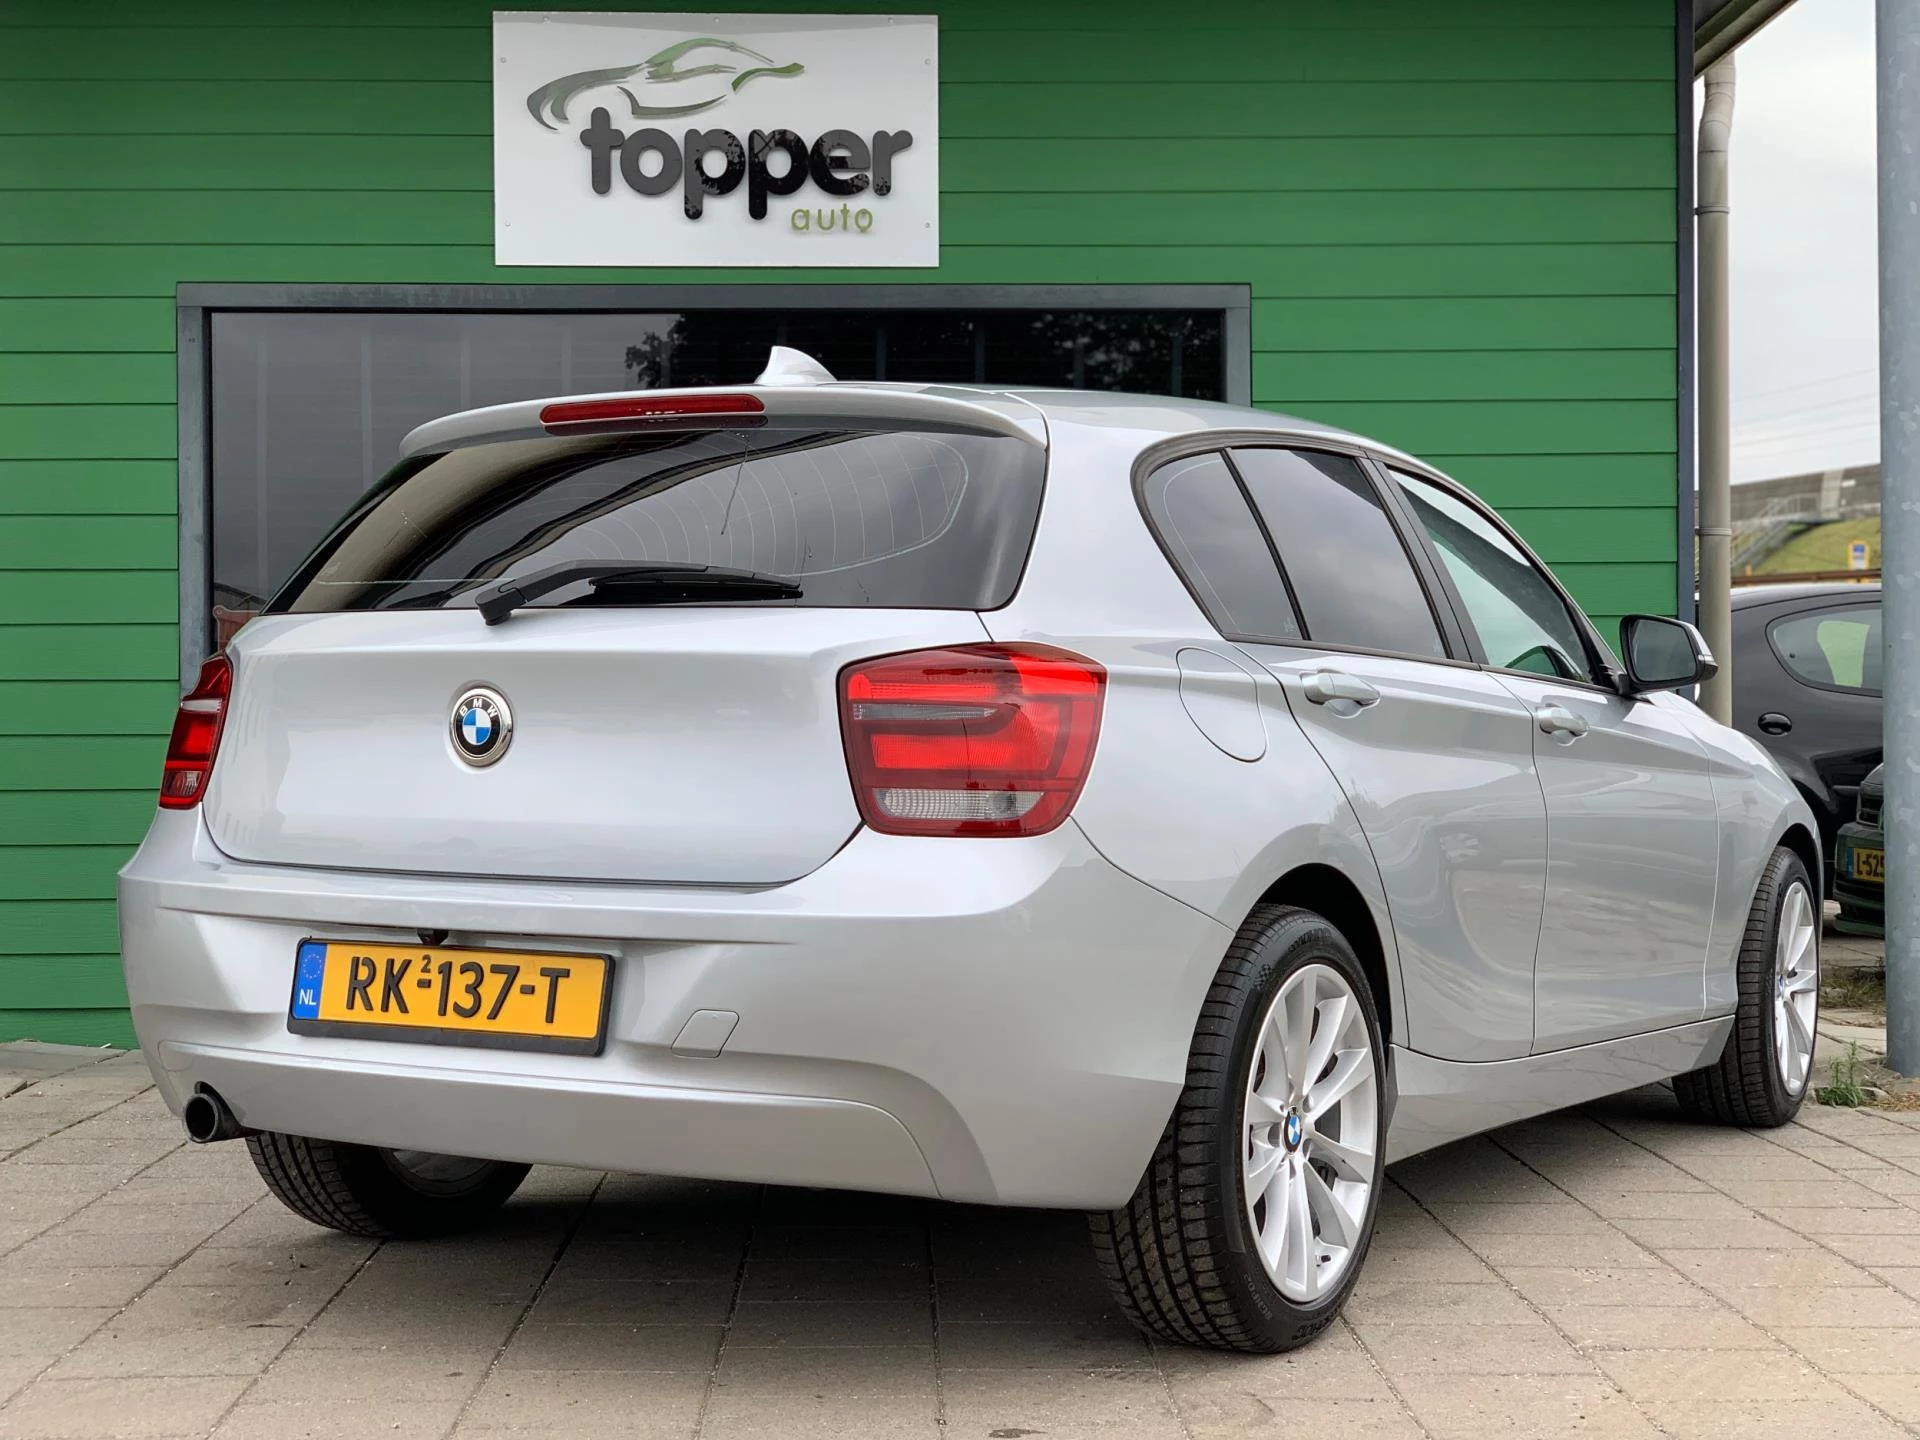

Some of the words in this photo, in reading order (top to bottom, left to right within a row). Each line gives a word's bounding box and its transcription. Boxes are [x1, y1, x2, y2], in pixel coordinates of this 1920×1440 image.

[579, 106, 914, 221] topper
[790, 203, 874, 232] auto
[459, 698, 498, 718] BMW
[298, 988, 317, 1006] NL
